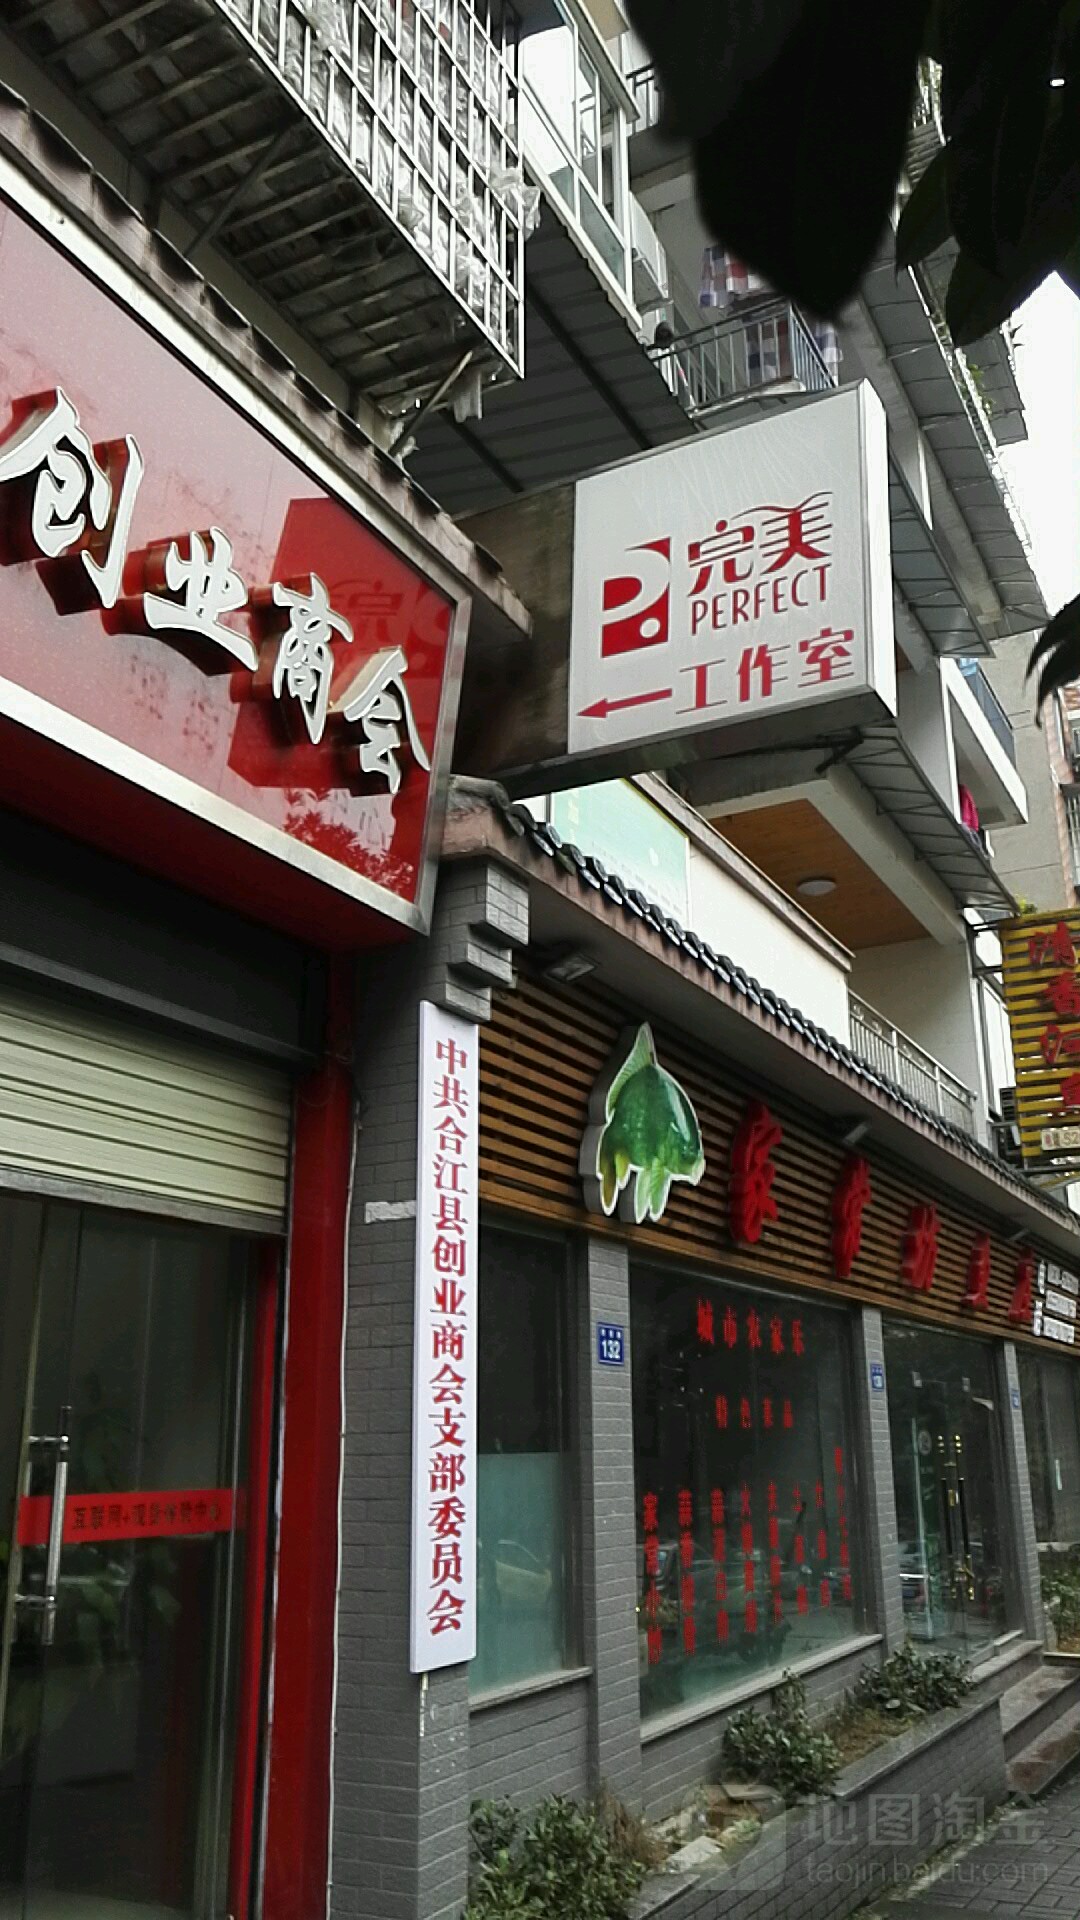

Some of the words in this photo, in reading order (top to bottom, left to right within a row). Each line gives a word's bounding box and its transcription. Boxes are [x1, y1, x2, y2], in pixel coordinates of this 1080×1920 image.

[0, 386, 431, 794] 创业商会
[687, 491, 833, 597] 完美
[691, 563, 833, 636] PERFECT
[675, 627, 854, 714] 工作室
[427, 1038, 469, 1636] 中共合江县创业商会支部委员会
[601, 1339, 621, 1359] 132
